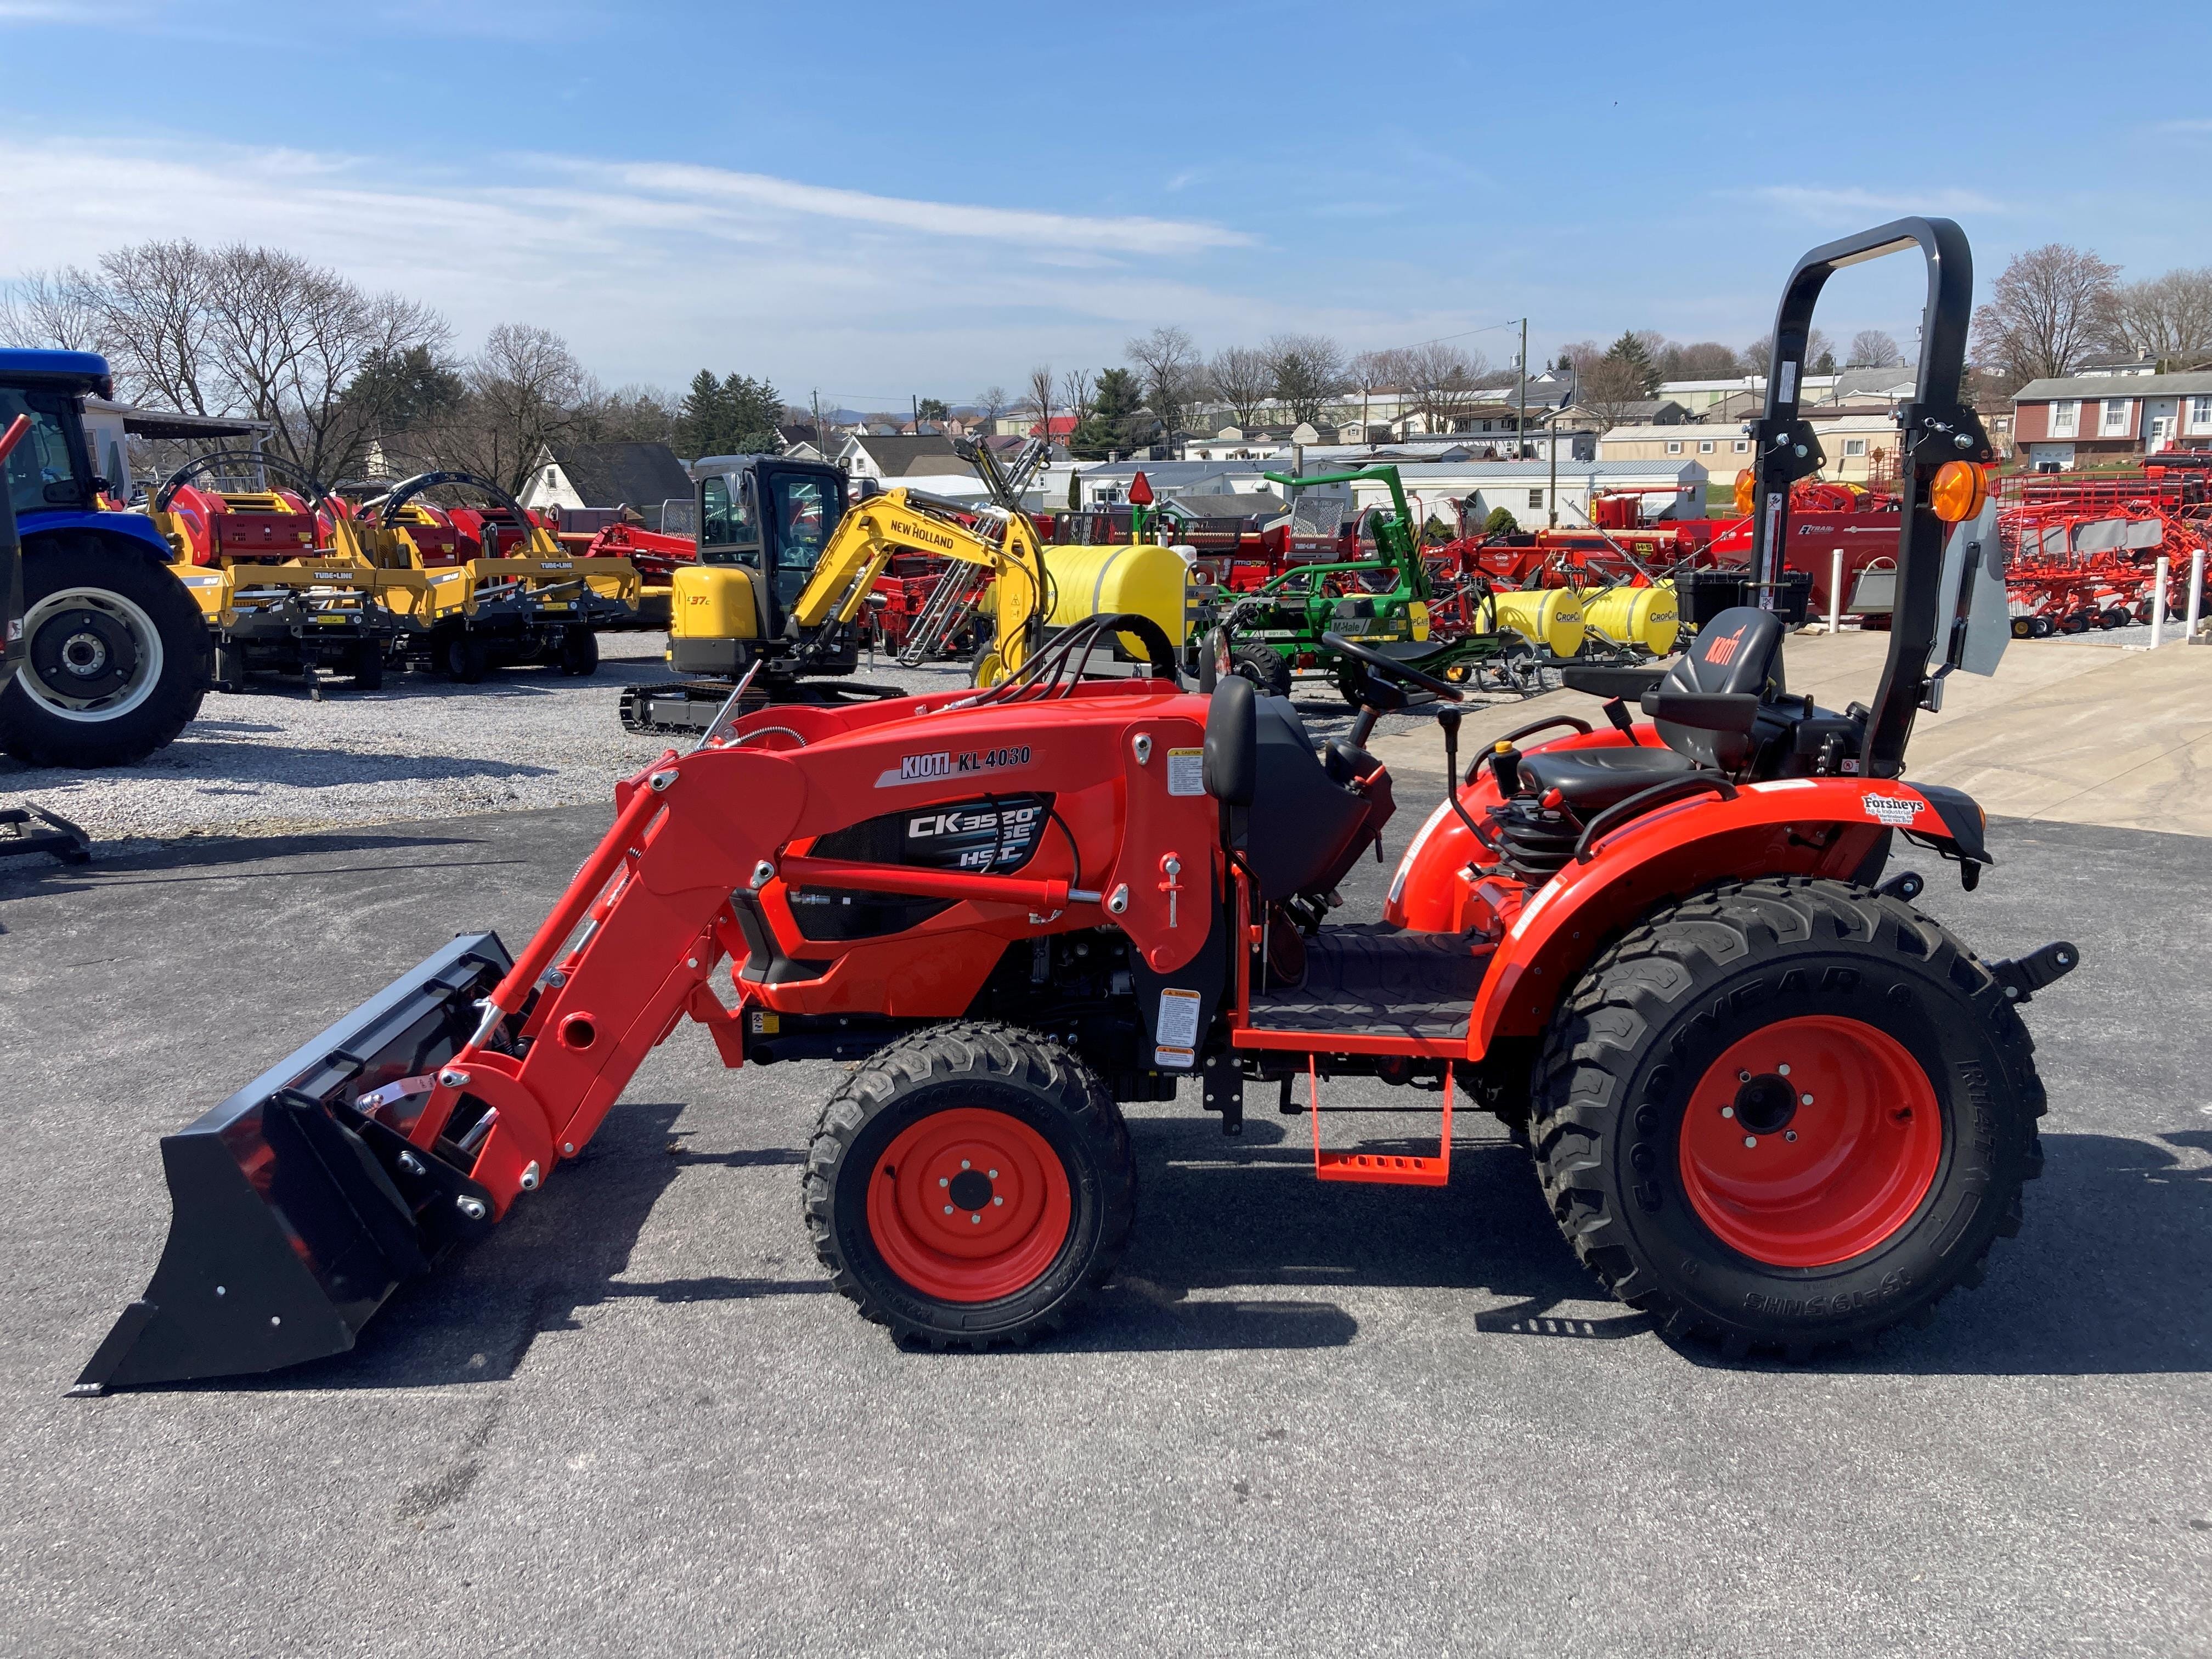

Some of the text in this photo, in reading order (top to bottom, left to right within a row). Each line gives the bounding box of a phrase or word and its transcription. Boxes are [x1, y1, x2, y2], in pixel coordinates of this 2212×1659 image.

[890, 520, 953, 549] NEW HOLLAND
[1705, 636, 1740, 665] KIOTI
[901, 746, 1031, 779] KIOTI KL 4030
[1863, 797, 1923, 813] Forsheys
[995, 823, 1032, 841] SE
[960, 847, 1015, 867] HST
[1629, 966, 1861, 1214] GOODYEAR
